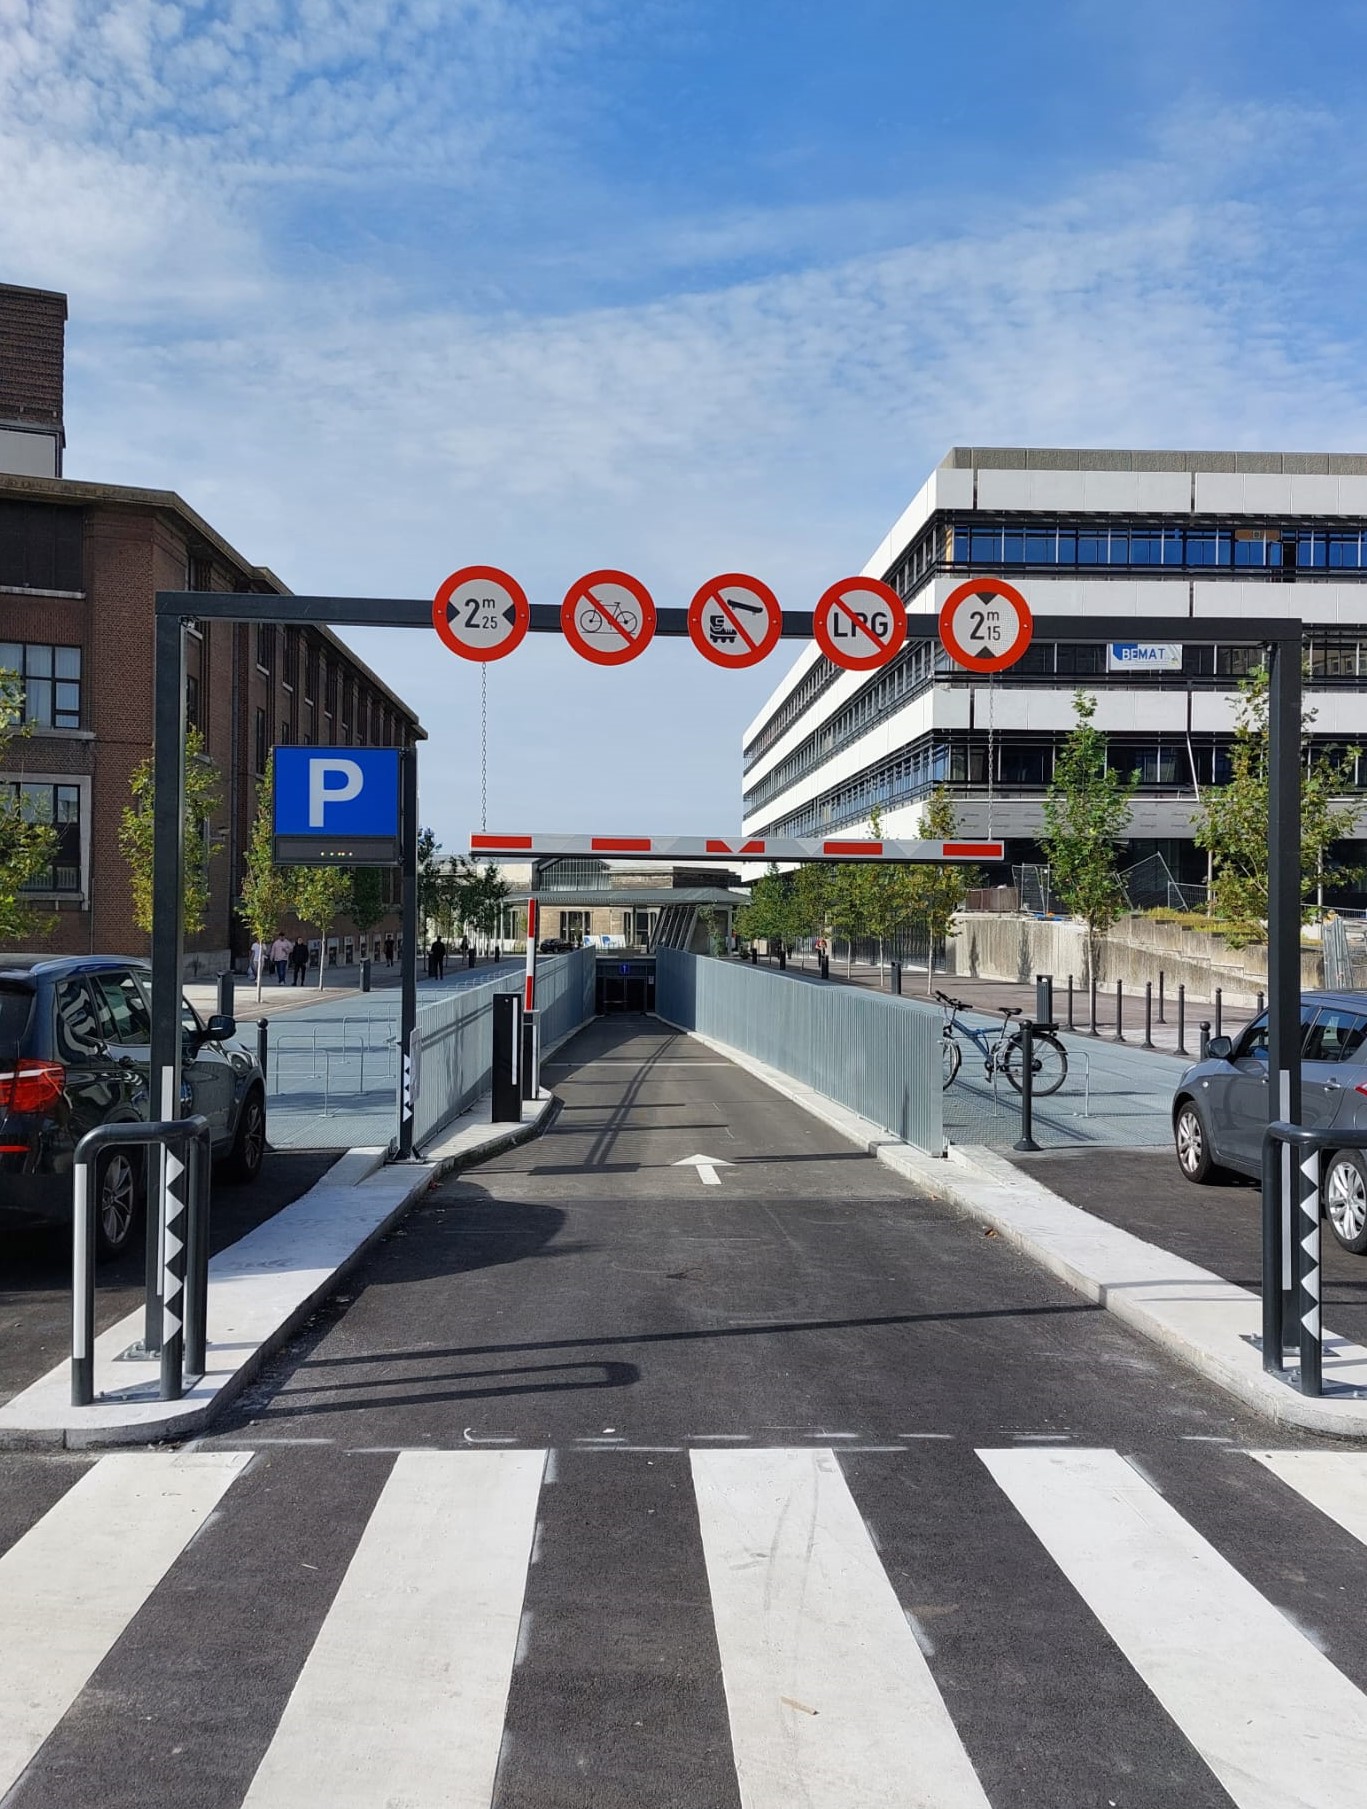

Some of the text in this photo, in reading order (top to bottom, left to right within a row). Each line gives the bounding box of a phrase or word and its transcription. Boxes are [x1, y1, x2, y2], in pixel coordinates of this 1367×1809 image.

[465, 598, 480, 628] 2
[482, 616, 498, 629] 25
[833, 611, 888, 638] LPG
[970, 611, 985, 640] 2
[987, 625, 1001, 641] 15
[1122, 648, 1166, 660] BEMAT
[309, 758, 364, 828] P
